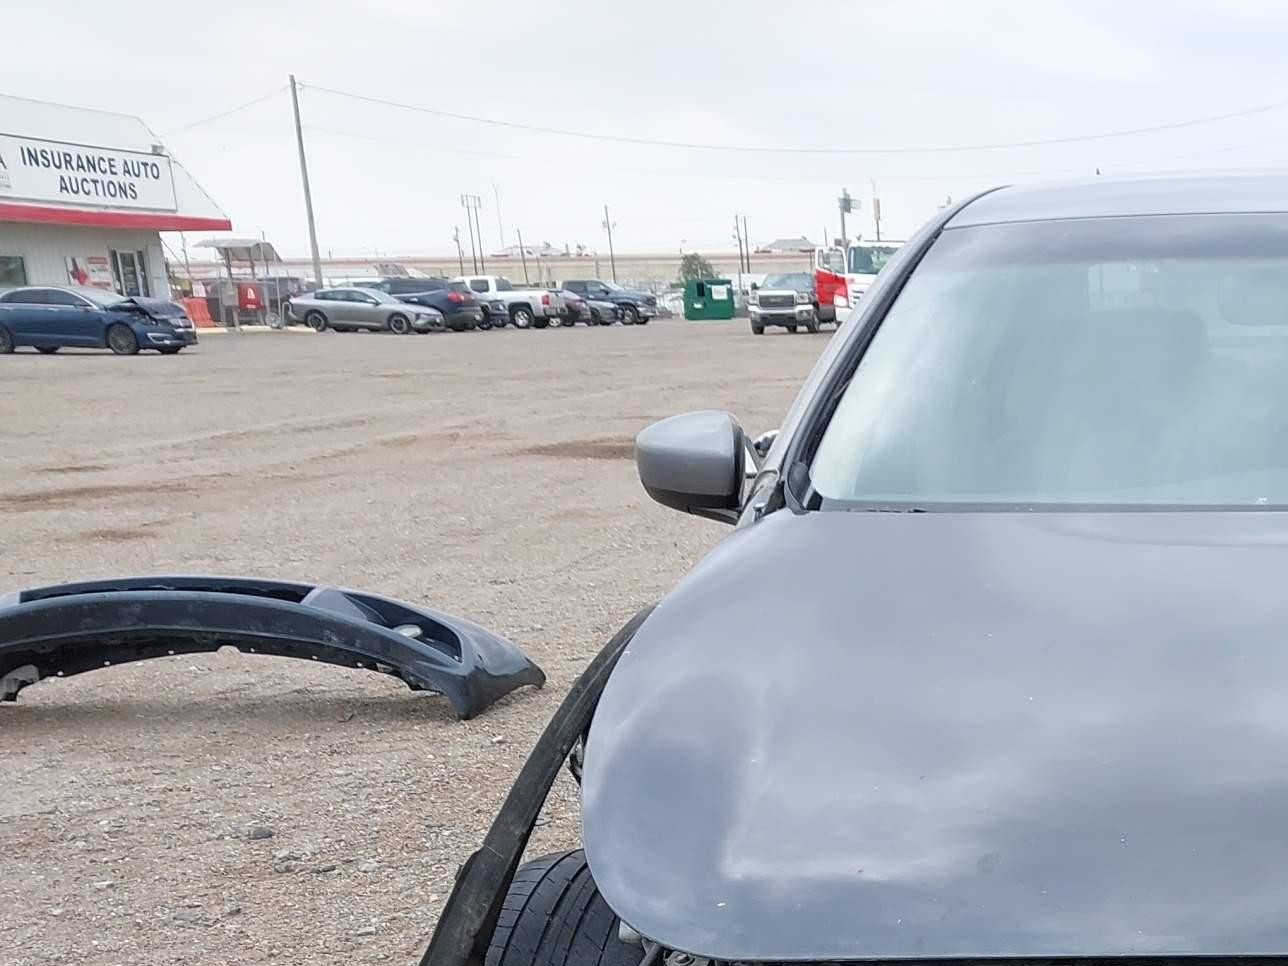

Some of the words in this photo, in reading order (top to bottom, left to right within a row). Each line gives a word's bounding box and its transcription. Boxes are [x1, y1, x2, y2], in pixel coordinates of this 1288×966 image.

[20, 146, 118, 176] INSURANCE
[122, 159, 161, 180] AUTO
[59, 175, 138, 200] AUCTIONS
